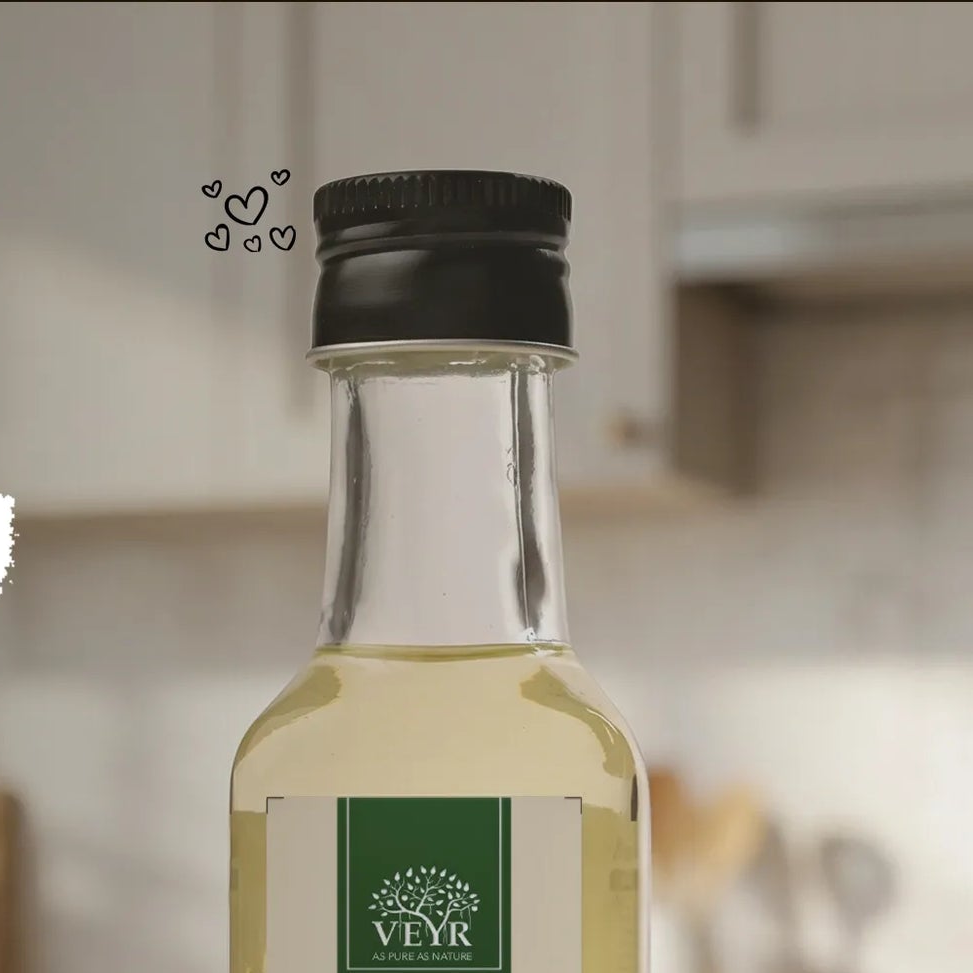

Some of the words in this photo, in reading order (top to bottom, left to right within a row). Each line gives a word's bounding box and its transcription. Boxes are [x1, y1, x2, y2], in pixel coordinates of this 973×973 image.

[371, 920, 472, 947] VEYR
[372, 952, 386, 961] AS
[388, 952, 415, 961] PURE
[416, 952, 429, 961] AS
[432, 952, 473, 961] NATURE
